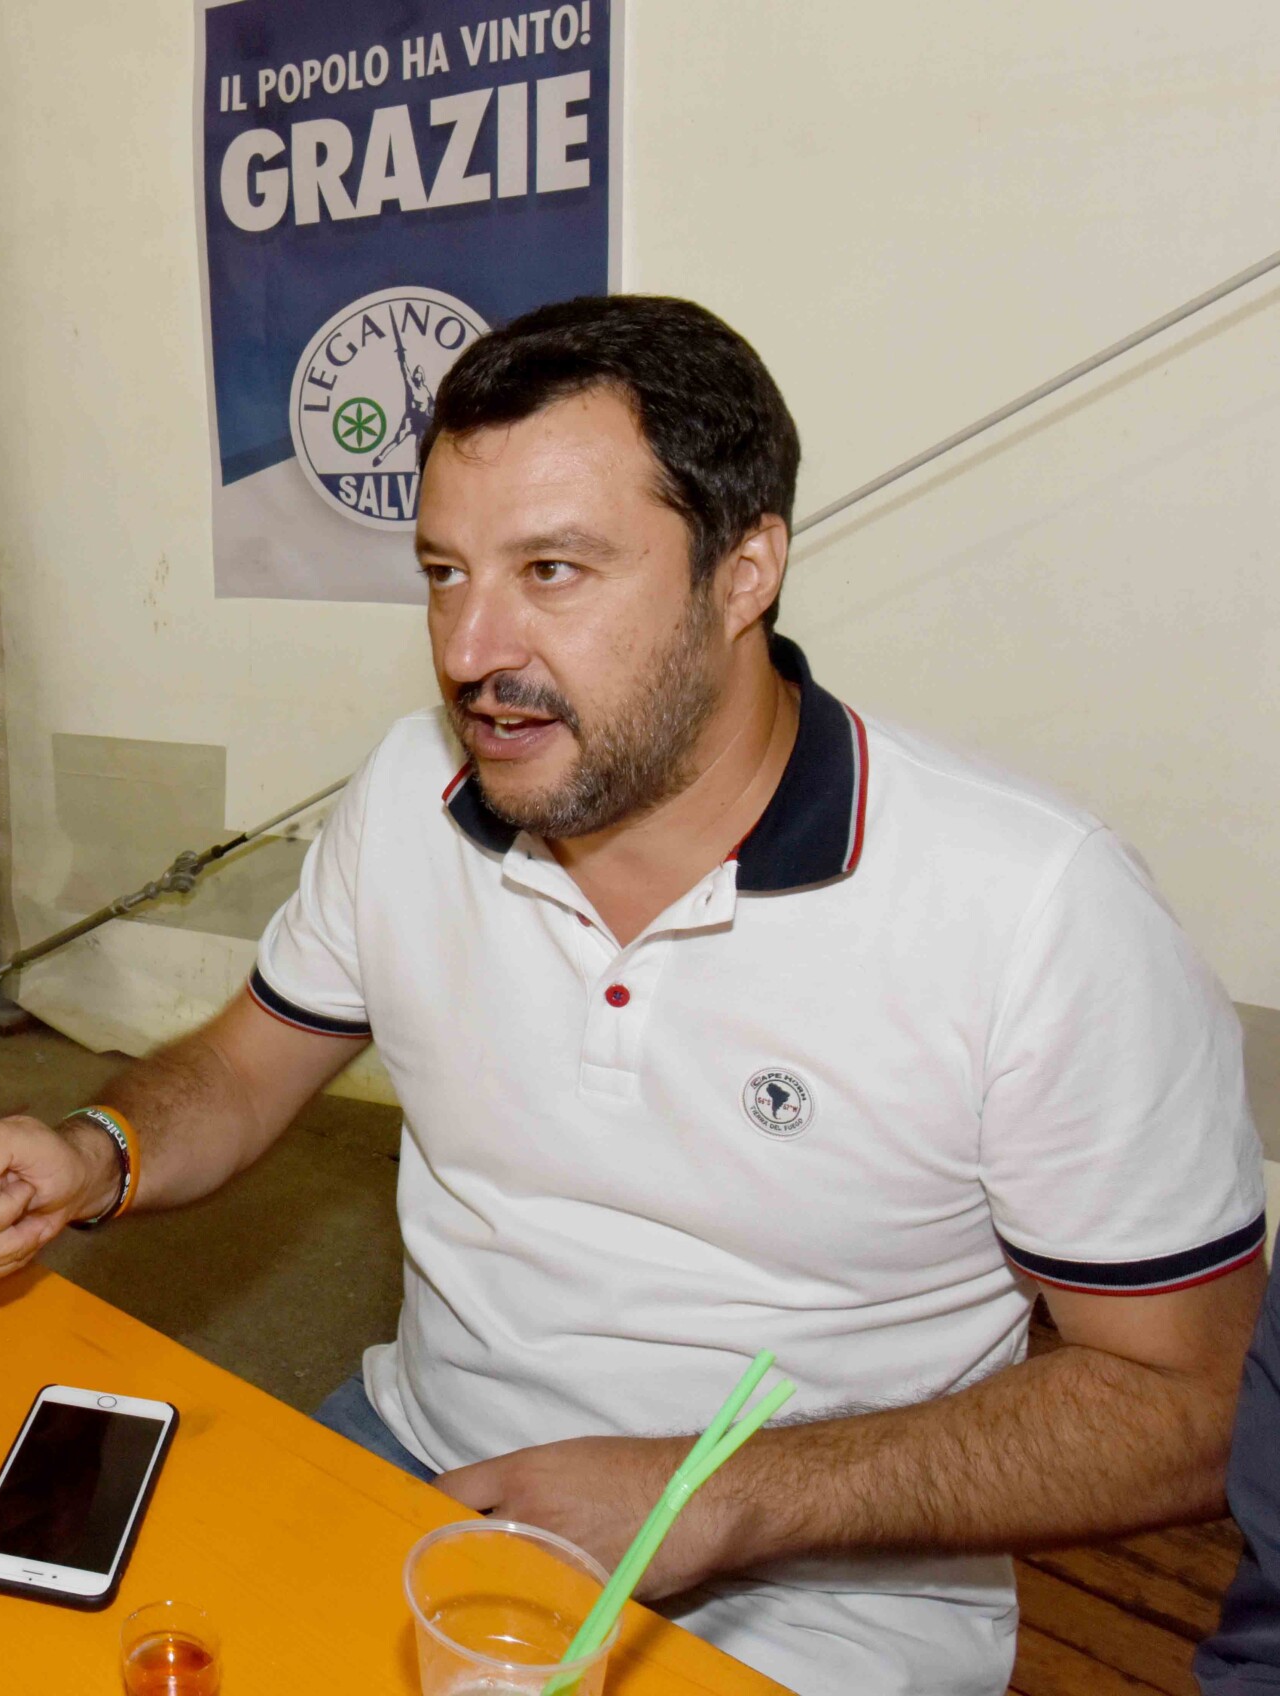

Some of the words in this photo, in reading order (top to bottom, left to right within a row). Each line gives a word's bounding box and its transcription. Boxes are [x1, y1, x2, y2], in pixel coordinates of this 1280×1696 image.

[220, 76, 247, 112] IL
[258, 45, 389, 108] POPOLO
[402, 33, 449, 80] HA
[460, 1, 591, 67] VINTO!
[220, 70, 591, 232] GRAZIE
[304, 314, 386, 412] LEGA
[401, 302, 466, 350] NO
[338, 475, 419, 519] SALV
[750, 1073, 782, 1090] CAPE
[784, 1074, 807, 1101] HORN
[750, 1105, 768, 1127] TIERRA
[769, 1123, 782, 1131] DEL
[784, 1118, 803, 1131] FUEGO
